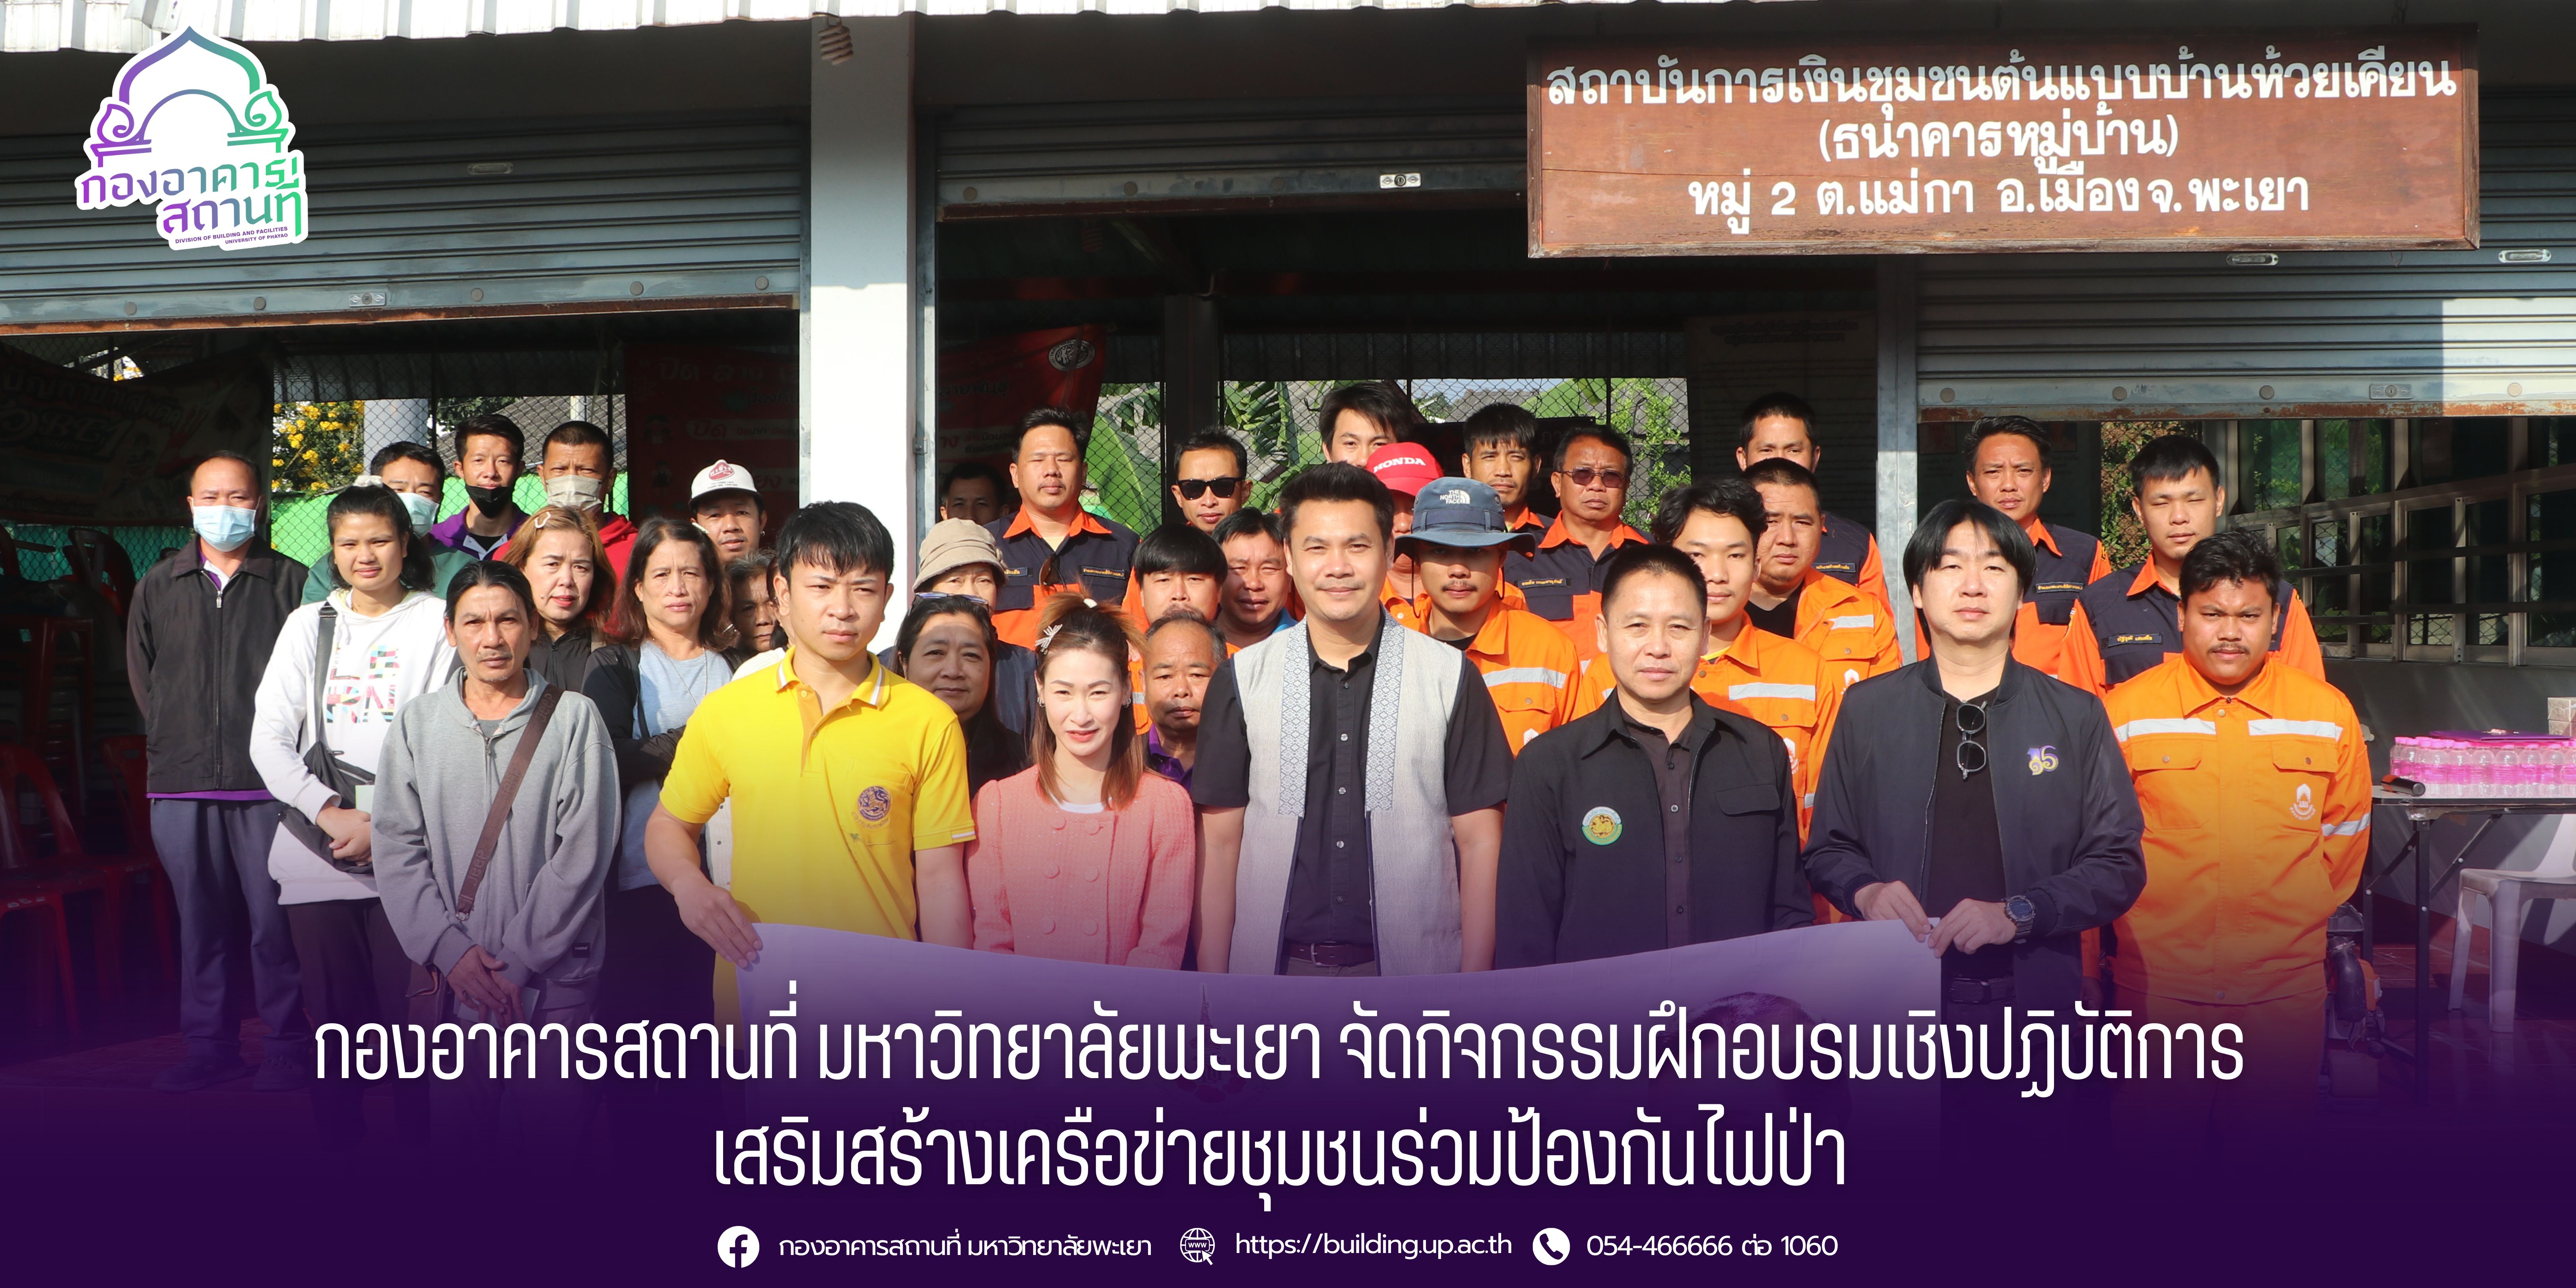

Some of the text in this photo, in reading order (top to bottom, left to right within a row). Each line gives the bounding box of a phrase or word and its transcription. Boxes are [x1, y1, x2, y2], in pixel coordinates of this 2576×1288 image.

[1546, 45, 2457, 120] สถาบันการเงินชุมชนต้นแบบบ้านห้วยเคียน
[1819, 101, 2178, 175] (ธนาคารหมู่บ้าน)
[1688, 168, 1751, 234] หมู่
[1771, 182, 1796, 215] 2
[1817, 167, 1973, 215] ต.แม่กา
[1373, 457, 1426, 473] HONDA
